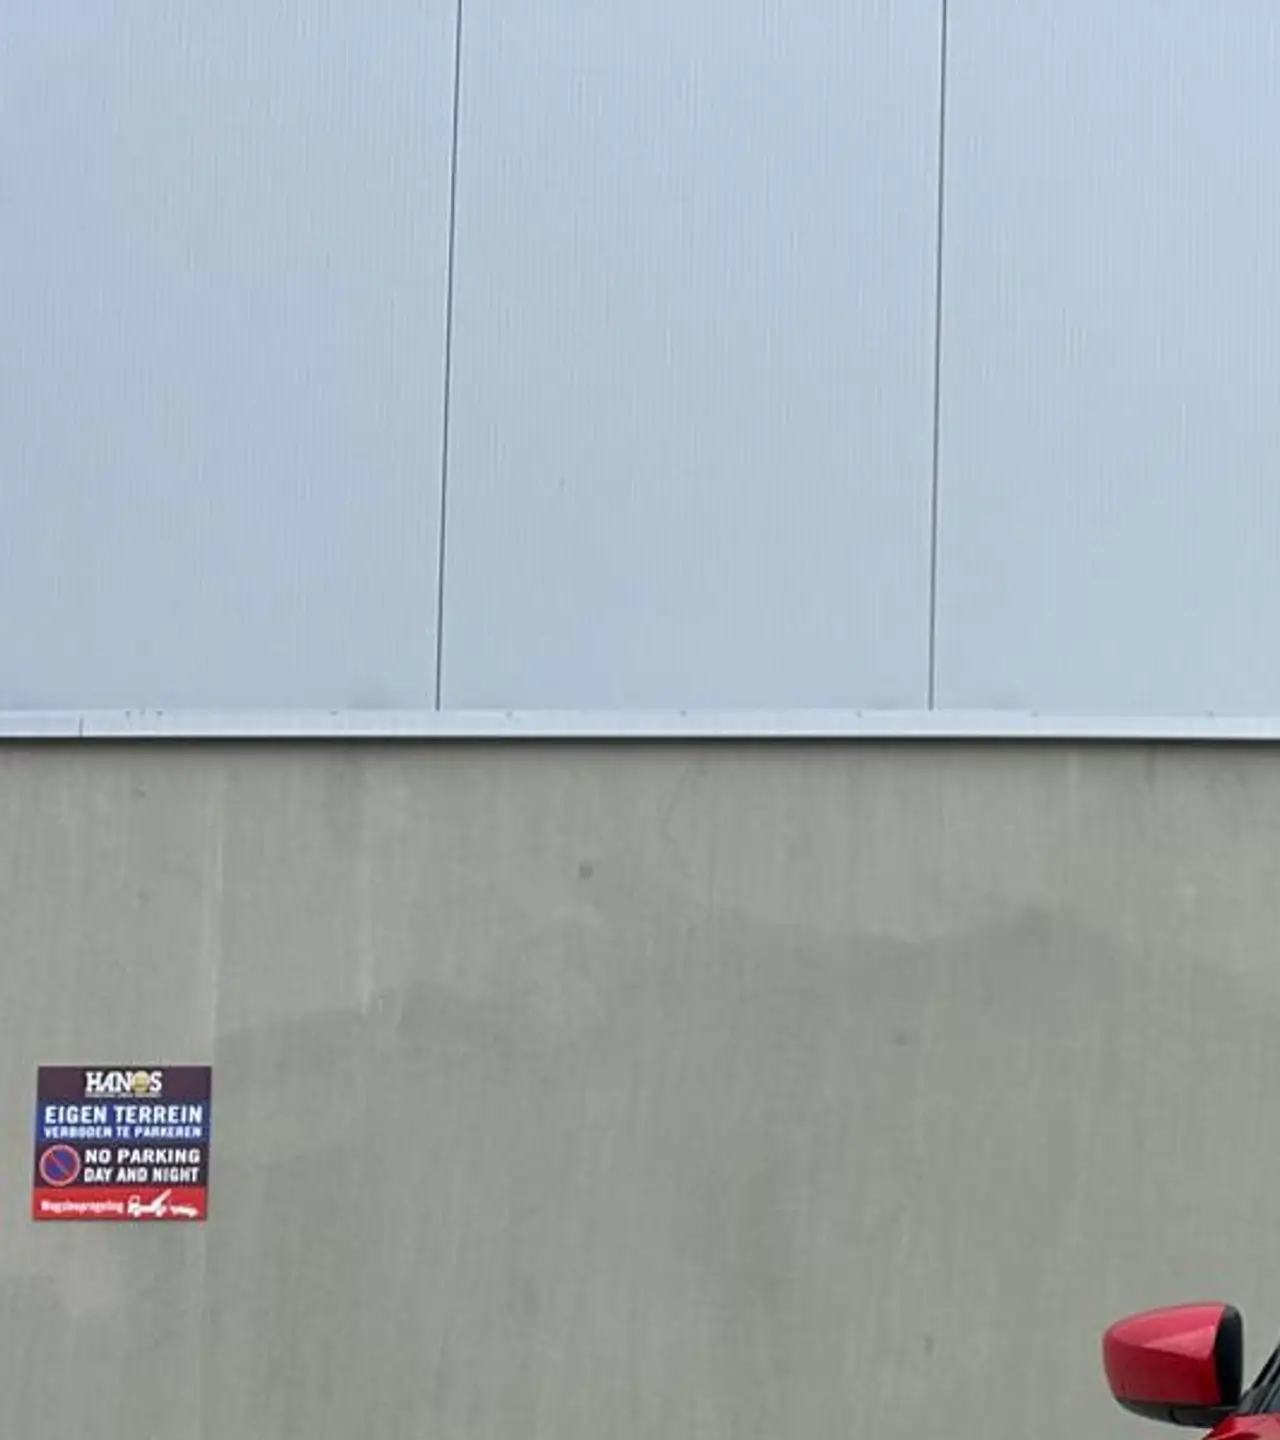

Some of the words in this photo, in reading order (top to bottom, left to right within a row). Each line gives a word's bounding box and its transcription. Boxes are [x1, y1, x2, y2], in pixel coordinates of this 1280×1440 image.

[85, 1070, 162, 1093] HANOS
[45, 1105, 107, 1124] EIGEN
[113, 1105, 203, 1124] TERREIN
[116, 1126, 129, 1138] TE
[85, 1148, 111, 1164] NO
[117, 1148, 200, 1164] PARKING
[84, 1167, 112, 1182] DAY
[115, 1167, 148, 1182] AND
[152, 1167, 199, 1182] NIGHT
